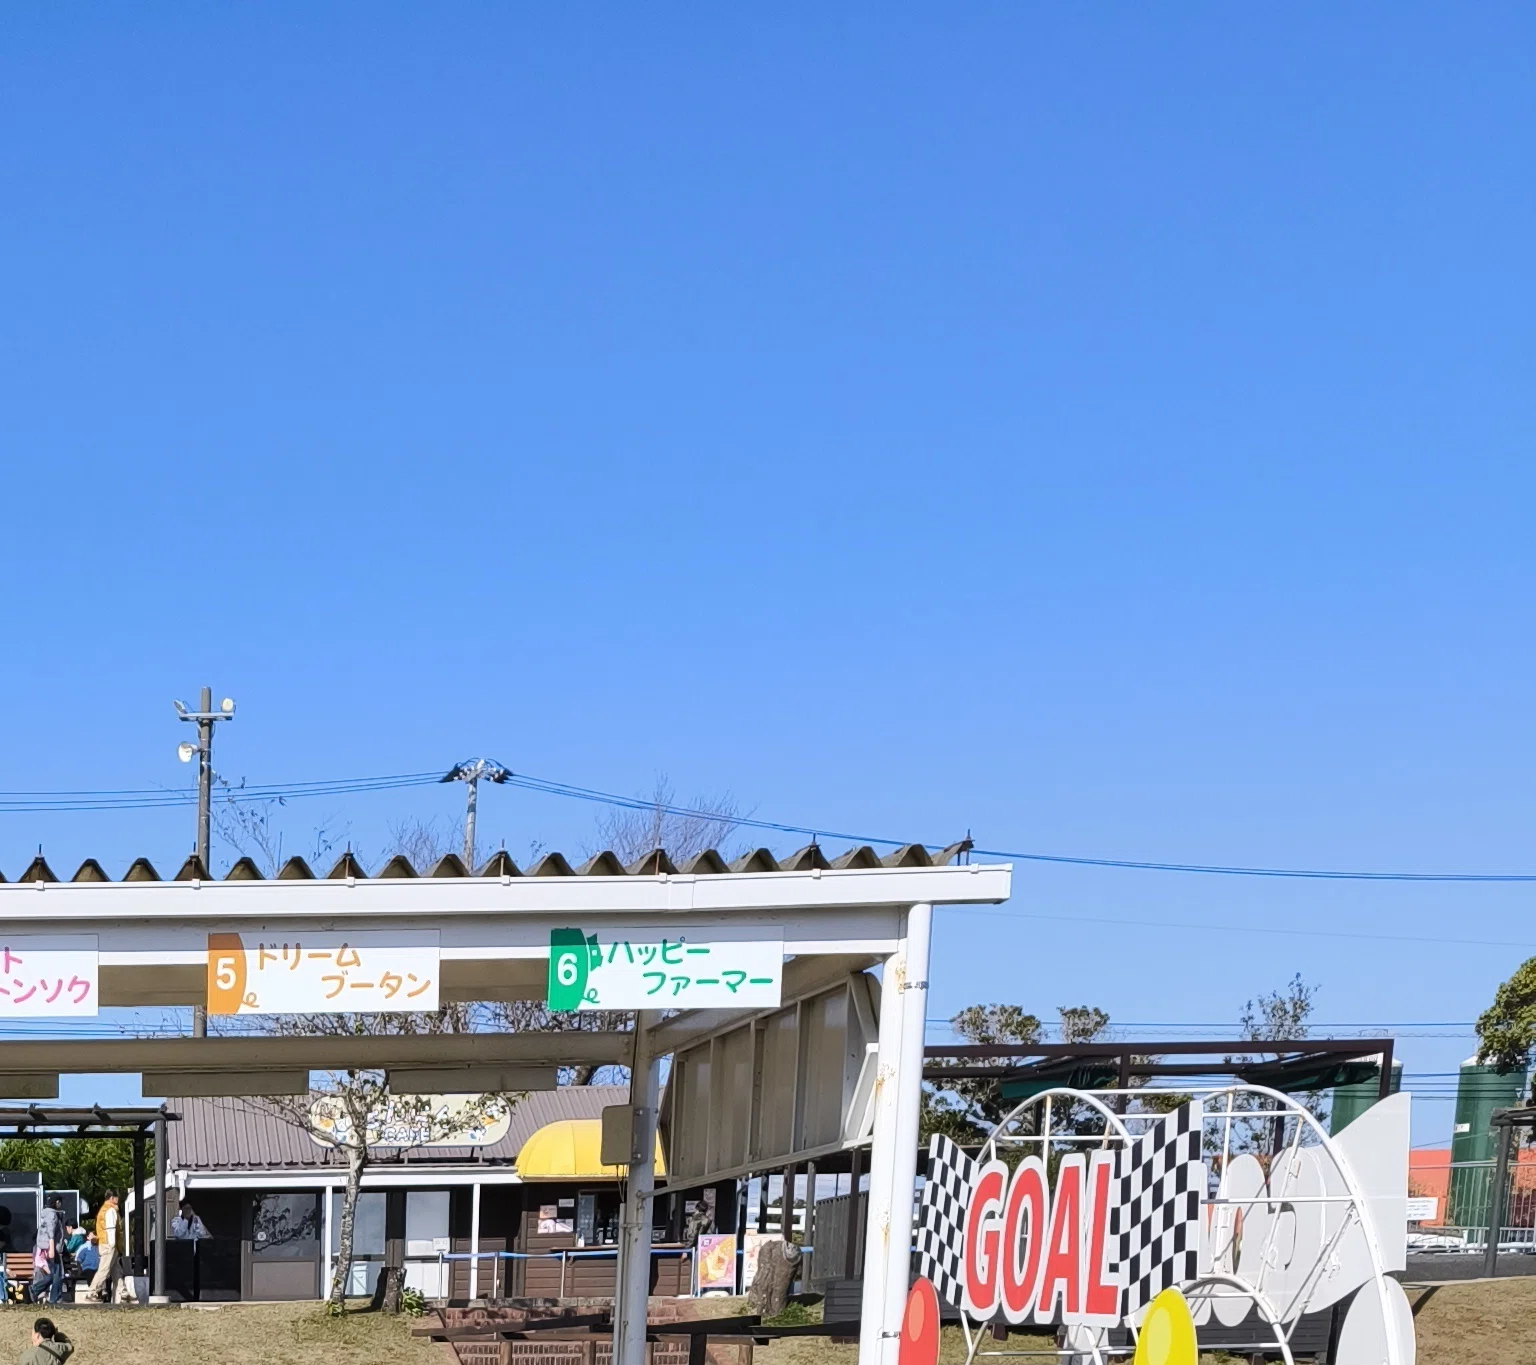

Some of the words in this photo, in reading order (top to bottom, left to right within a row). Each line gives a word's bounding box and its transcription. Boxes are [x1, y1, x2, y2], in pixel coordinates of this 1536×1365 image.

[259, 942, 361, 971] ドリーム
[608, 936, 711, 966] ハッピー
[216, 957, 237, 990] 5
[557, 952, 578, 986] 6
[643, 970, 773, 996] ファーマー
[321, 970, 431, 999] ブータン
[965, 1162, 1119, 1315] GOAL
